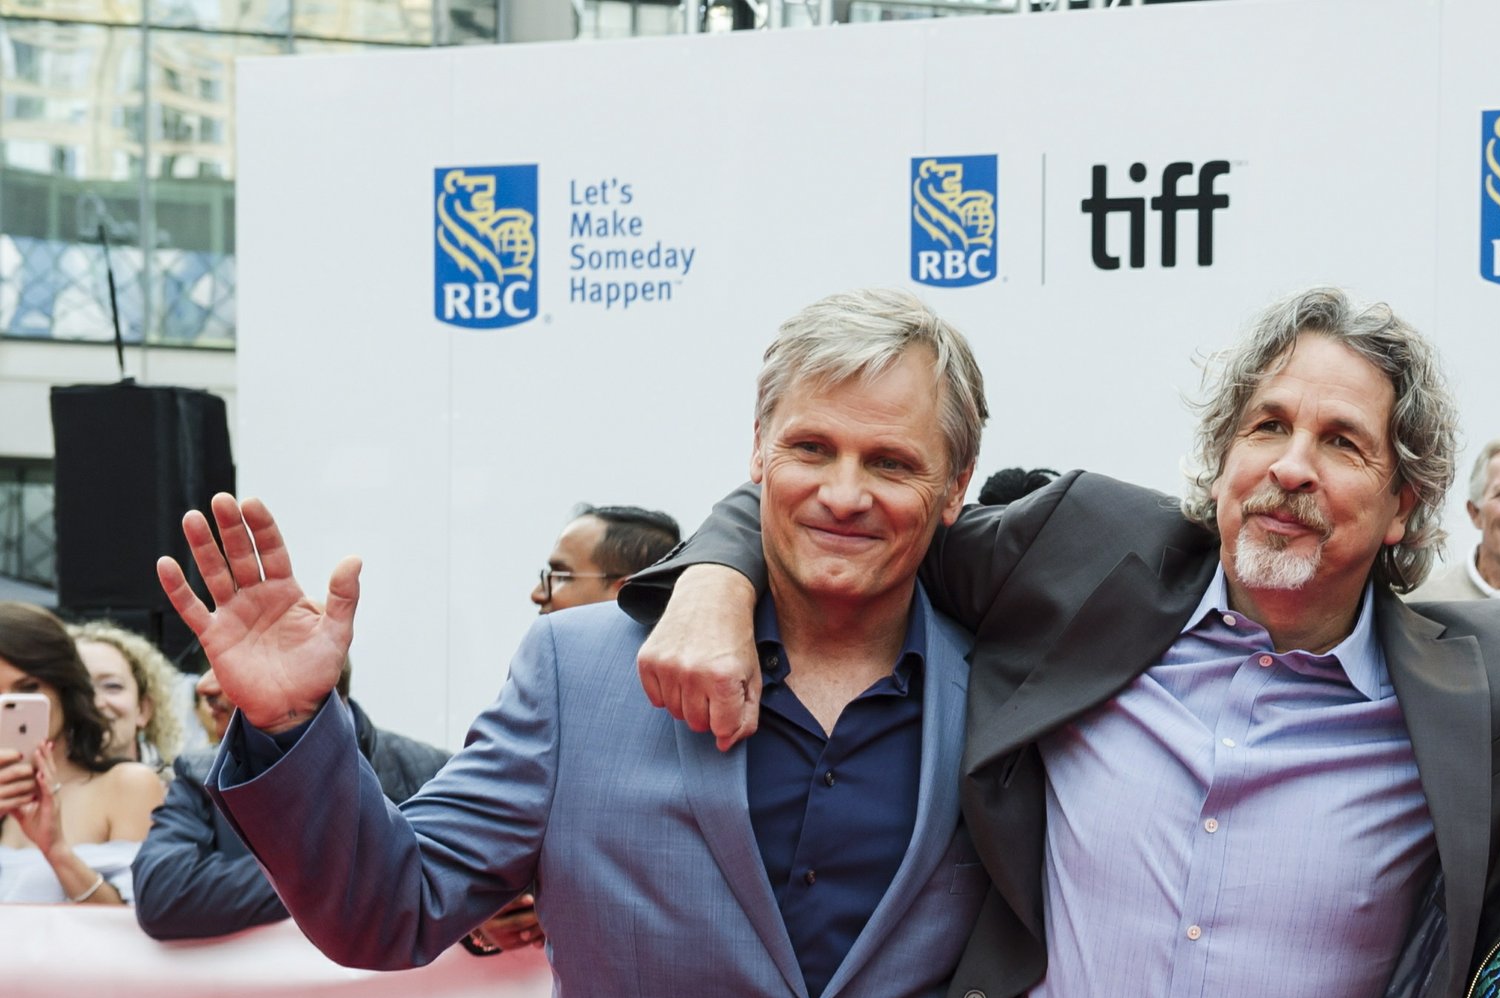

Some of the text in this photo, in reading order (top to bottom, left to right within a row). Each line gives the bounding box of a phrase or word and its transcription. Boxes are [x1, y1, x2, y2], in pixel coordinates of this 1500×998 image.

[570, 177, 634, 206] Let's
[570, 209, 643, 238] Make
[1081, 160, 1231, 271] tiff
[570, 239, 695, 276] Someday
[918, 248, 992, 281] RBC
[443, 280, 531, 320] RBC
